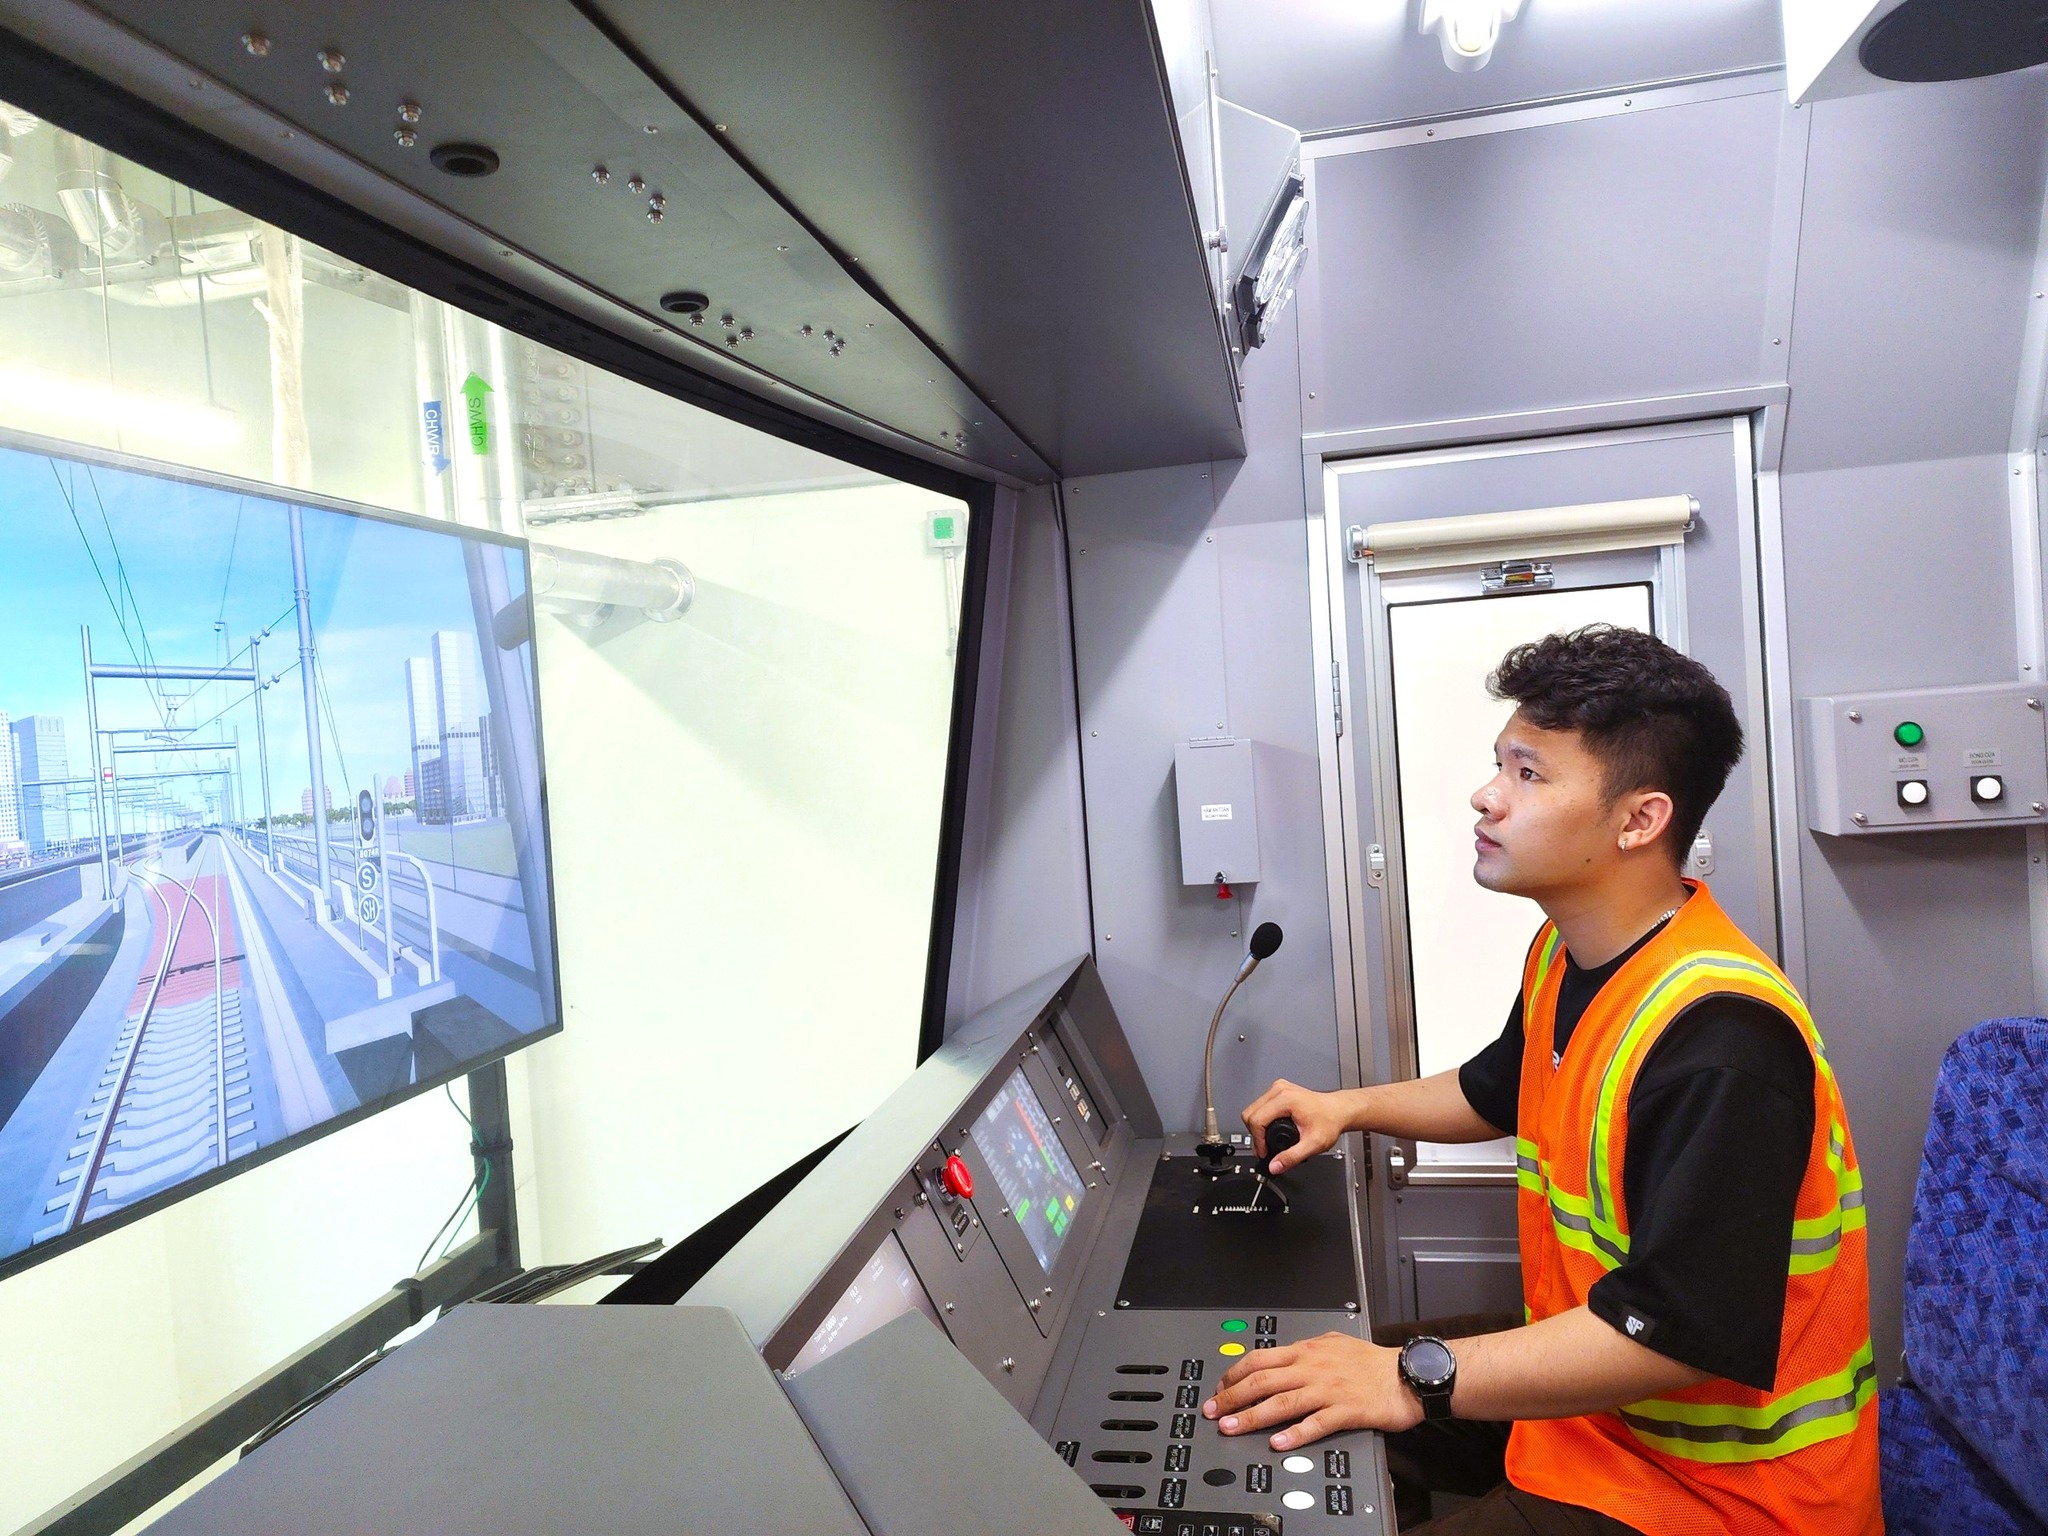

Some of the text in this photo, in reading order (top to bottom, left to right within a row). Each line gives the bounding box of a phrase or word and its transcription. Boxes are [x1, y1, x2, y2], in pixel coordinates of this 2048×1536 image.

[468, 397, 484, 447] CHWS
[361, 867, 372, 888] S
[363, 900, 376, 921] SH
